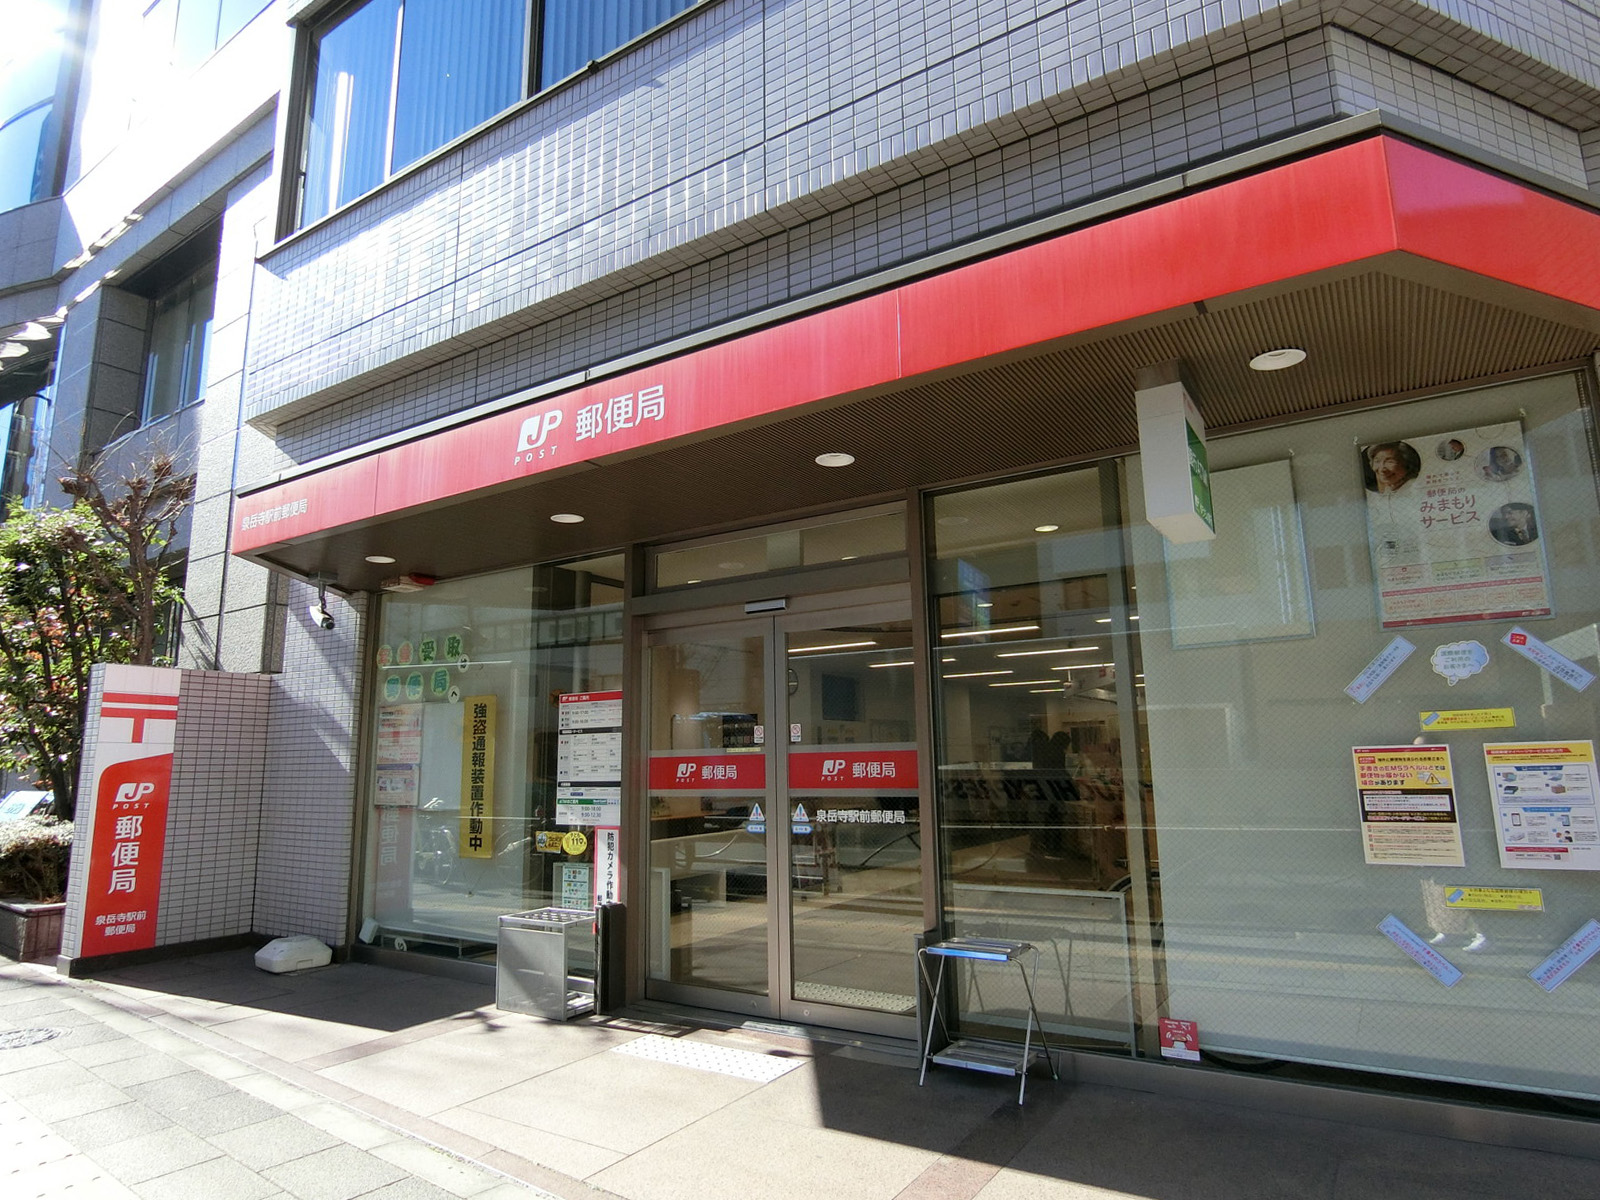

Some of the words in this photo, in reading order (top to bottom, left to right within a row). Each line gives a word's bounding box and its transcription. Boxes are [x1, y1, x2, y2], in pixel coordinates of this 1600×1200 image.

[575, 384, 665, 442] 郵便局
[517, 410, 563, 452] JP
[514, 446, 557, 466] POST
[1426, 487, 1465, 498] 郵便局の
[1420, 494, 1476, 513] みまもり
[241, 498, 308, 531] 泉岳寺駅前郵便局
[1420, 510, 1480, 529] サービス
[676, 763, 697, 778] JP
[701, 765, 737, 780] 郵便局
[822, 759, 846, 775] JP
[852, 761, 896, 778] 郵便局
[469, 703, 488, 851] 強盗通報装置作動中
[114, 782, 155, 803] JP
[816, 809, 906, 824] 泉岳寺駅前郵便局
[108, 815, 144, 895] 郵便局
[606, 832, 615, 904] 防犯カメラ作動
[95, 910, 147, 926] 泉岳寺駅前
[104, 923, 136, 937] 郵便局
